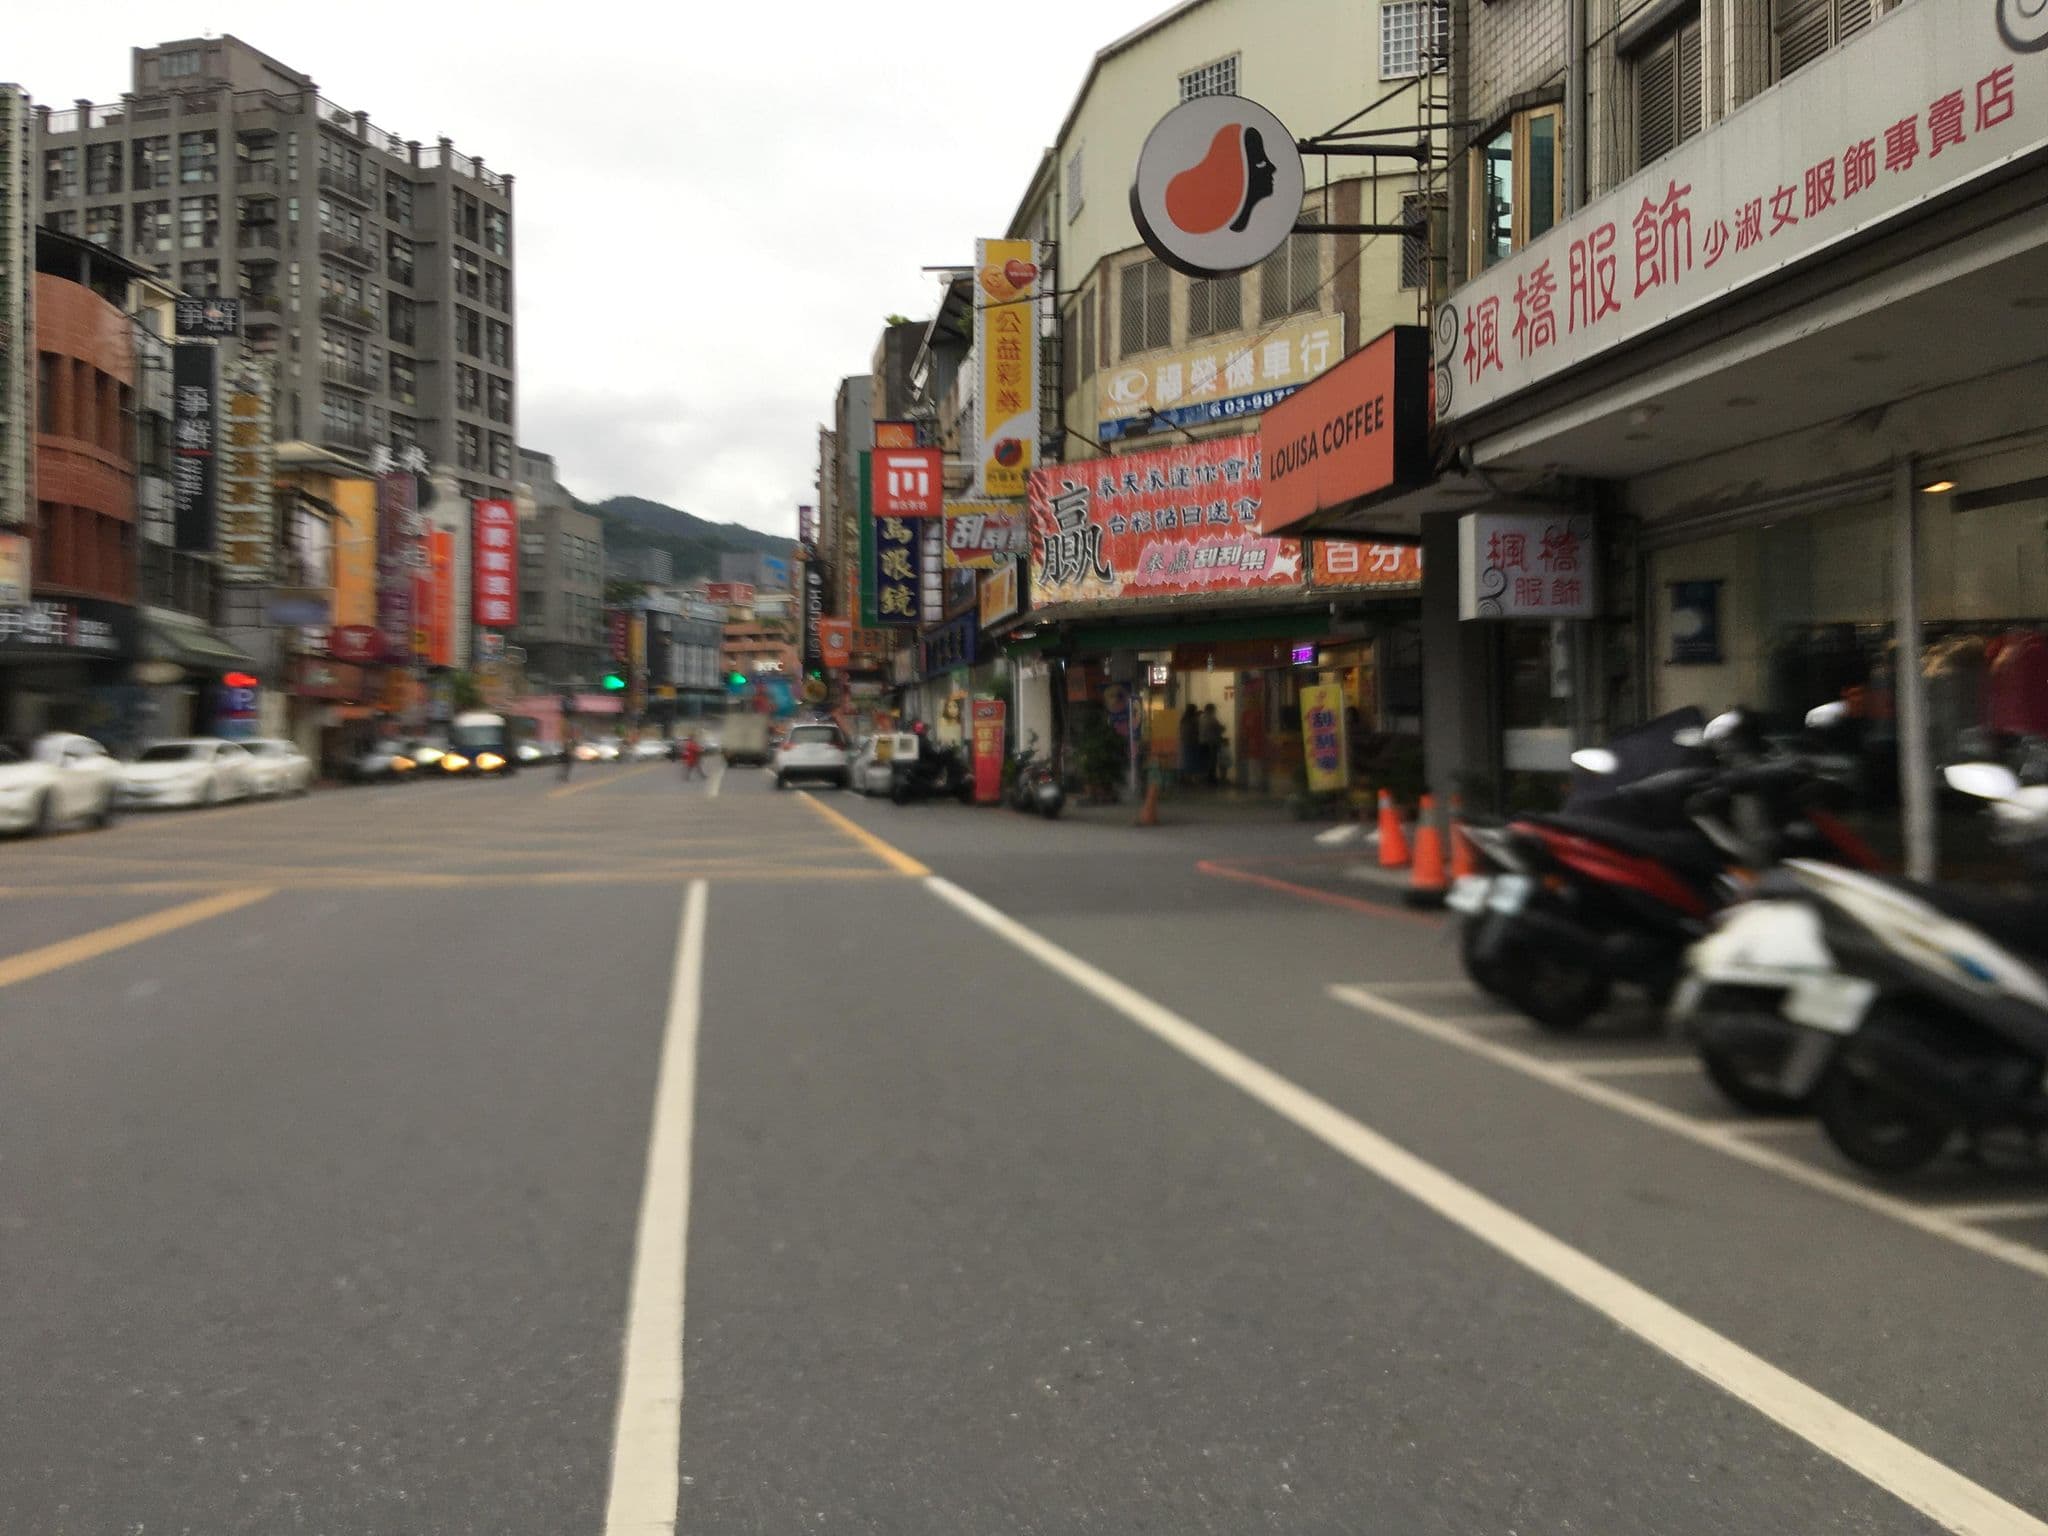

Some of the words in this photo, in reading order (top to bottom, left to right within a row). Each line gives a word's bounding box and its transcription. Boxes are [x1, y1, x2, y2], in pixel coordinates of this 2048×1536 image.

[1463, 180, 1692, 385] 楓橋服飾
[1704, 64, 2015, 269] 少淑女服飾專賣店
[996, 310, 1021, 412] 公益彩券
[1271, 432, 1318, 482] LOUISA
[1322, 393, 1384, 455] COFFEE
[1038, 480, 1114, 587] 贏
[1325, 540, 1422, 574] 百分
[1487, 530, 1583, 573] 楓橋
[1514, 577, 1581, 608] 服飾
